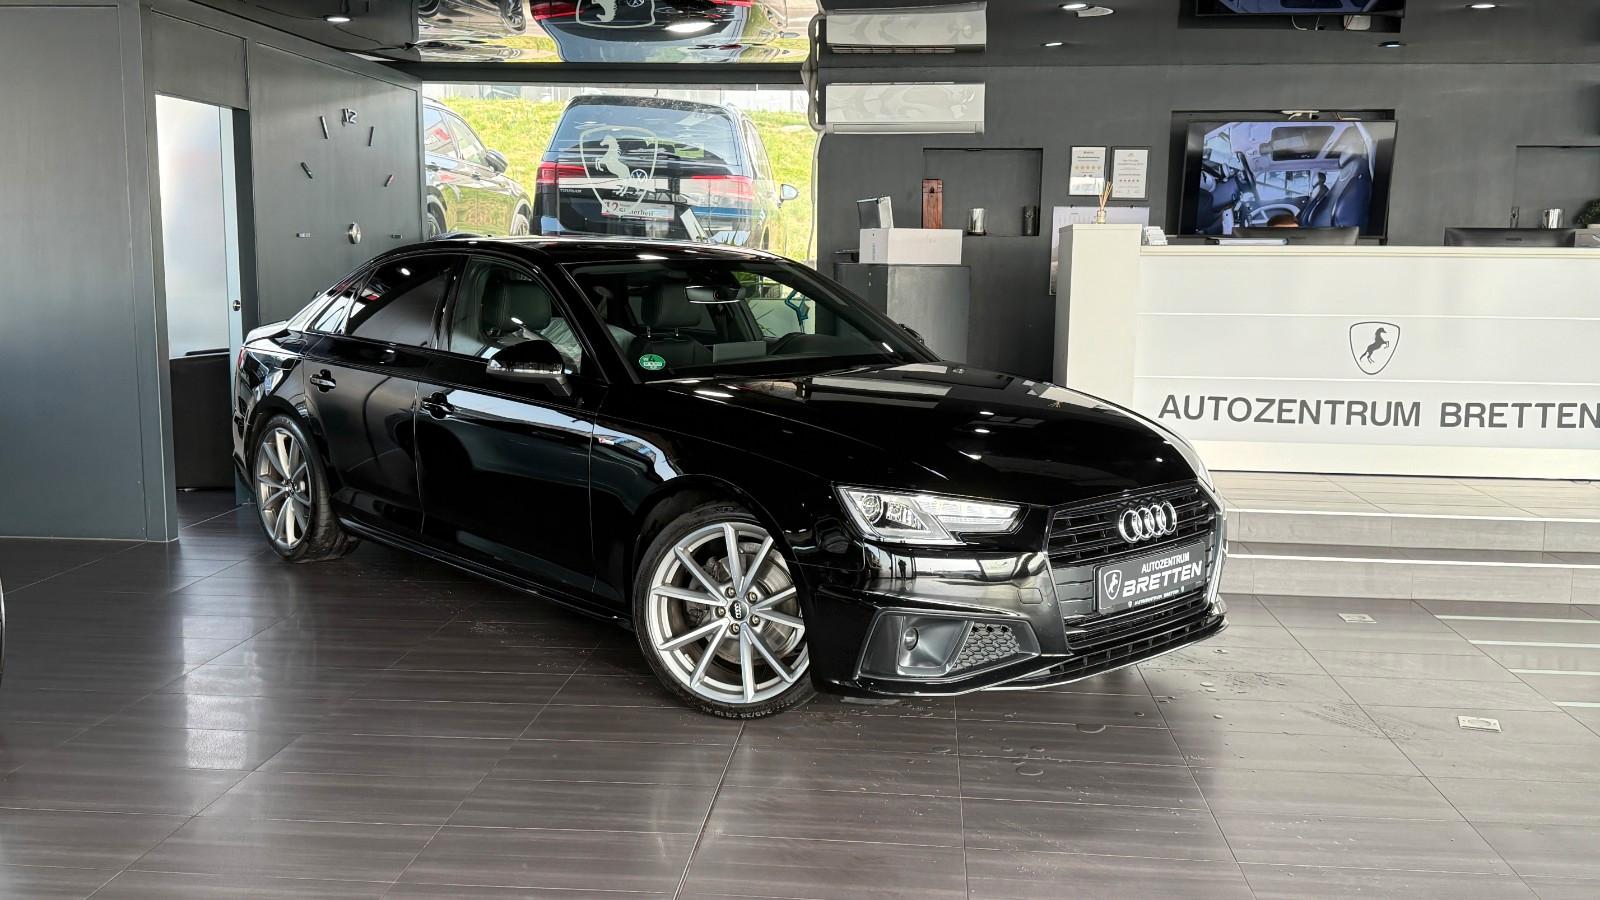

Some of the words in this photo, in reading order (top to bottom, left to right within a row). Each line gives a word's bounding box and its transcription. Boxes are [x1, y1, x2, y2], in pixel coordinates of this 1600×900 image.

[1158, 394, 1421, 427] AUTOZENTRUM
[1440, 401, 1600, 429] BRETTEN
[1122, 560, 1202, 597] BRETTEN
[1141, 552, 1189, 573] AUTOZENTRUM
